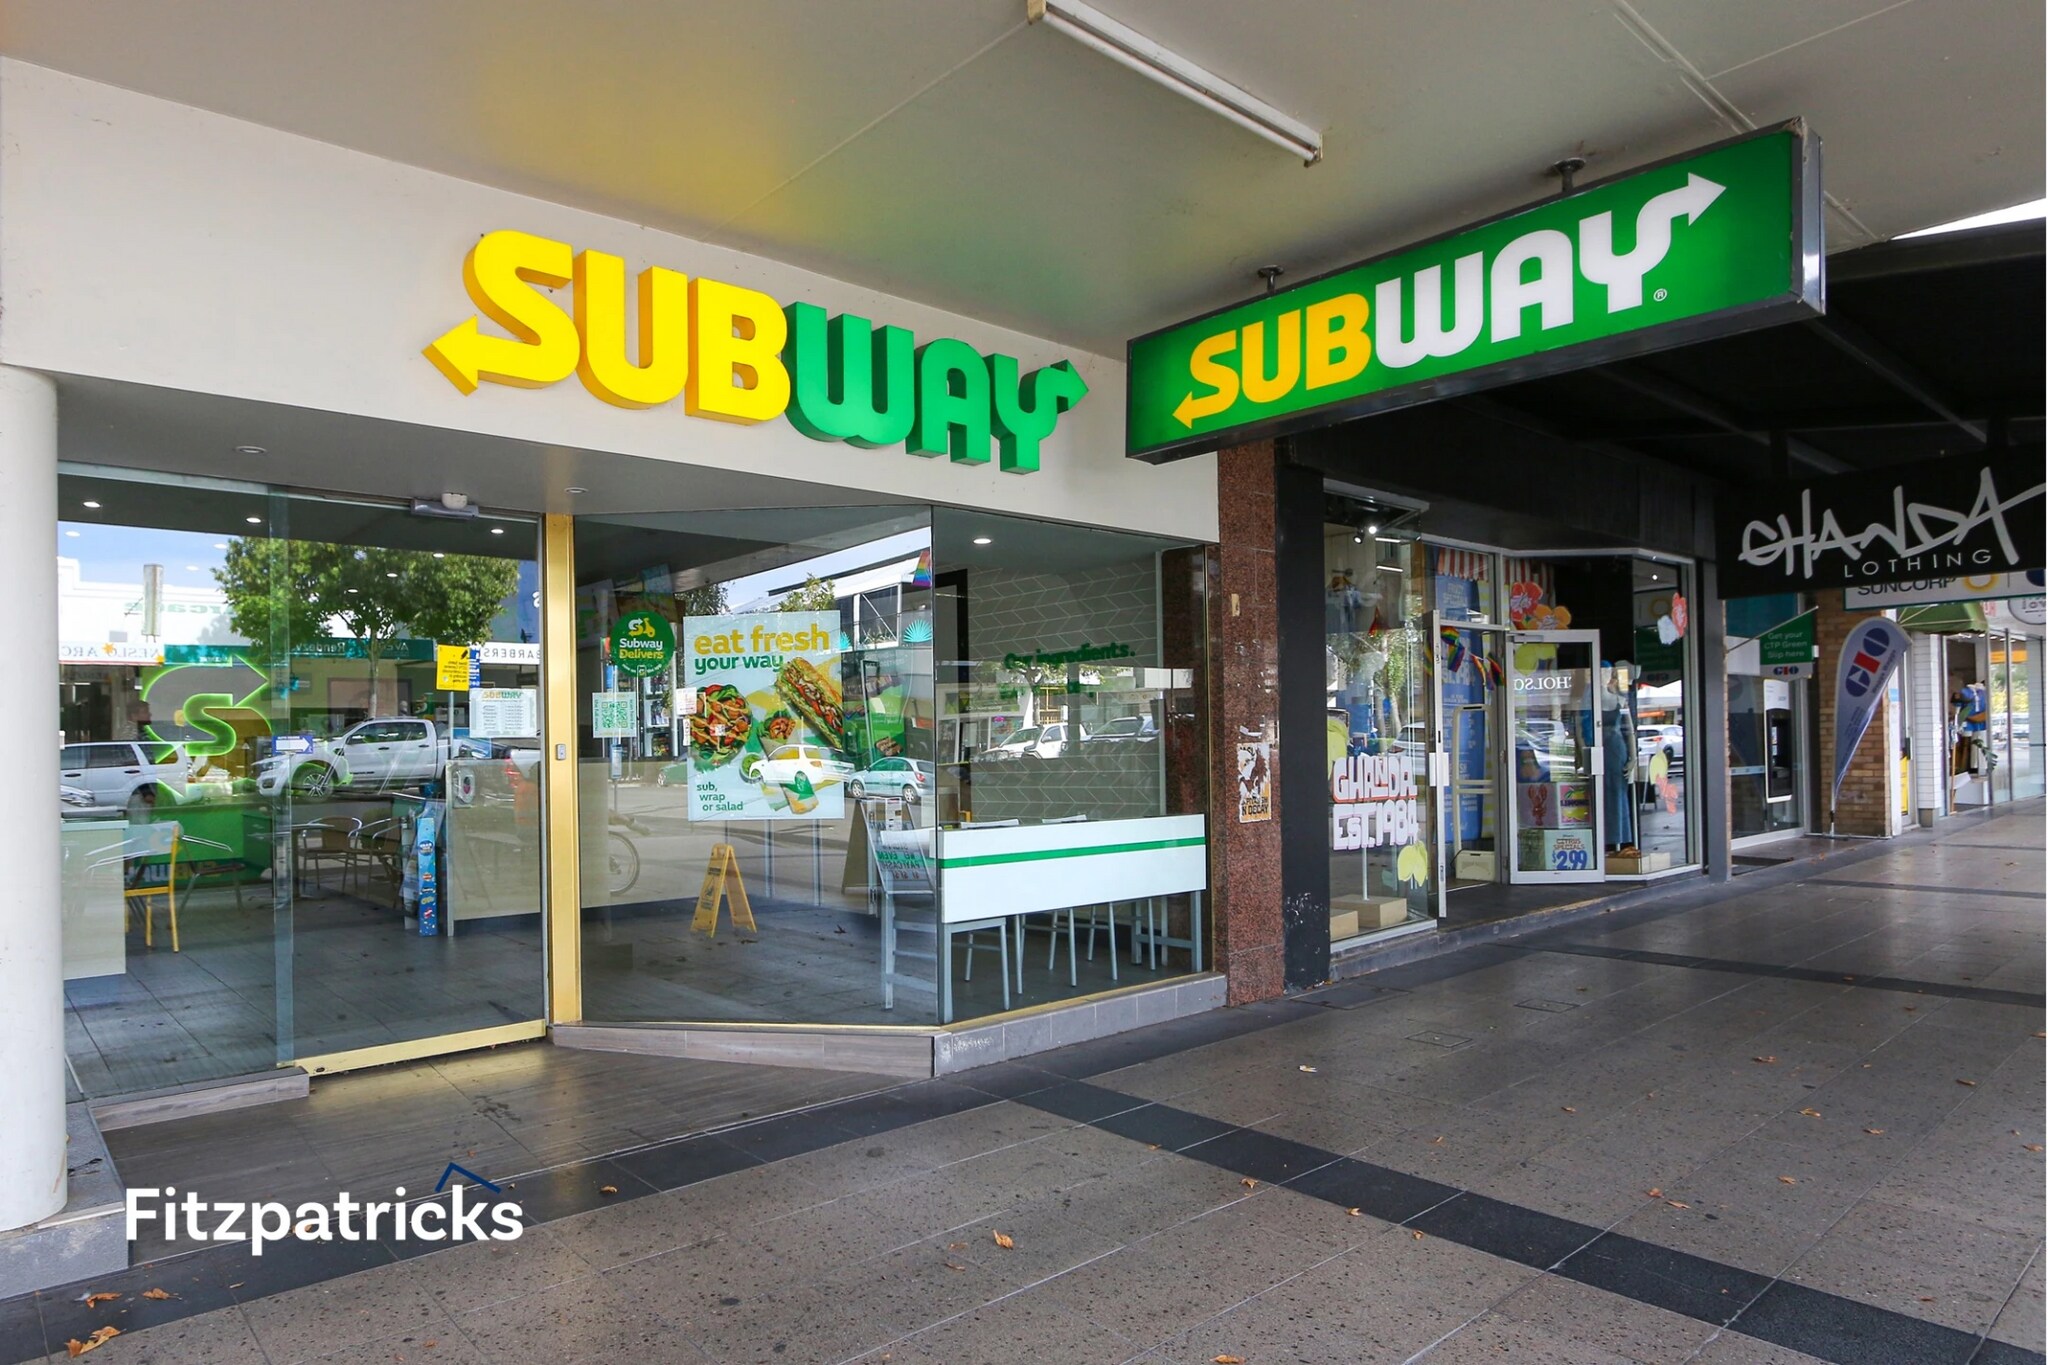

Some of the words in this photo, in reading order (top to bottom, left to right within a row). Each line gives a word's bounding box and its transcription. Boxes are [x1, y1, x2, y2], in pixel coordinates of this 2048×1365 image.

[1173, 172, 1727, 429] SUBWAY
[423, 230, 1089, 474] SUBWAY
[1844, 549, 1992, 578] LOTHING
[619, 638, 663, 650] Subway
[694, 629, 743, 655] eat
[750, 623, 829, 652] fresh
[1782, 640, 1807, 649] Green
[619, 648, 664, 659] Delivers
[694, 655, 739, 676] your
[742, 654, 783, 672] way
[696, 781, 718, 792] sub,
[699, 792, 725, 803] wrap
[702, 803, 713, 811] or
[715, 801, 744, 811] salad
[1248, 804, 1269, 815] DECAY
